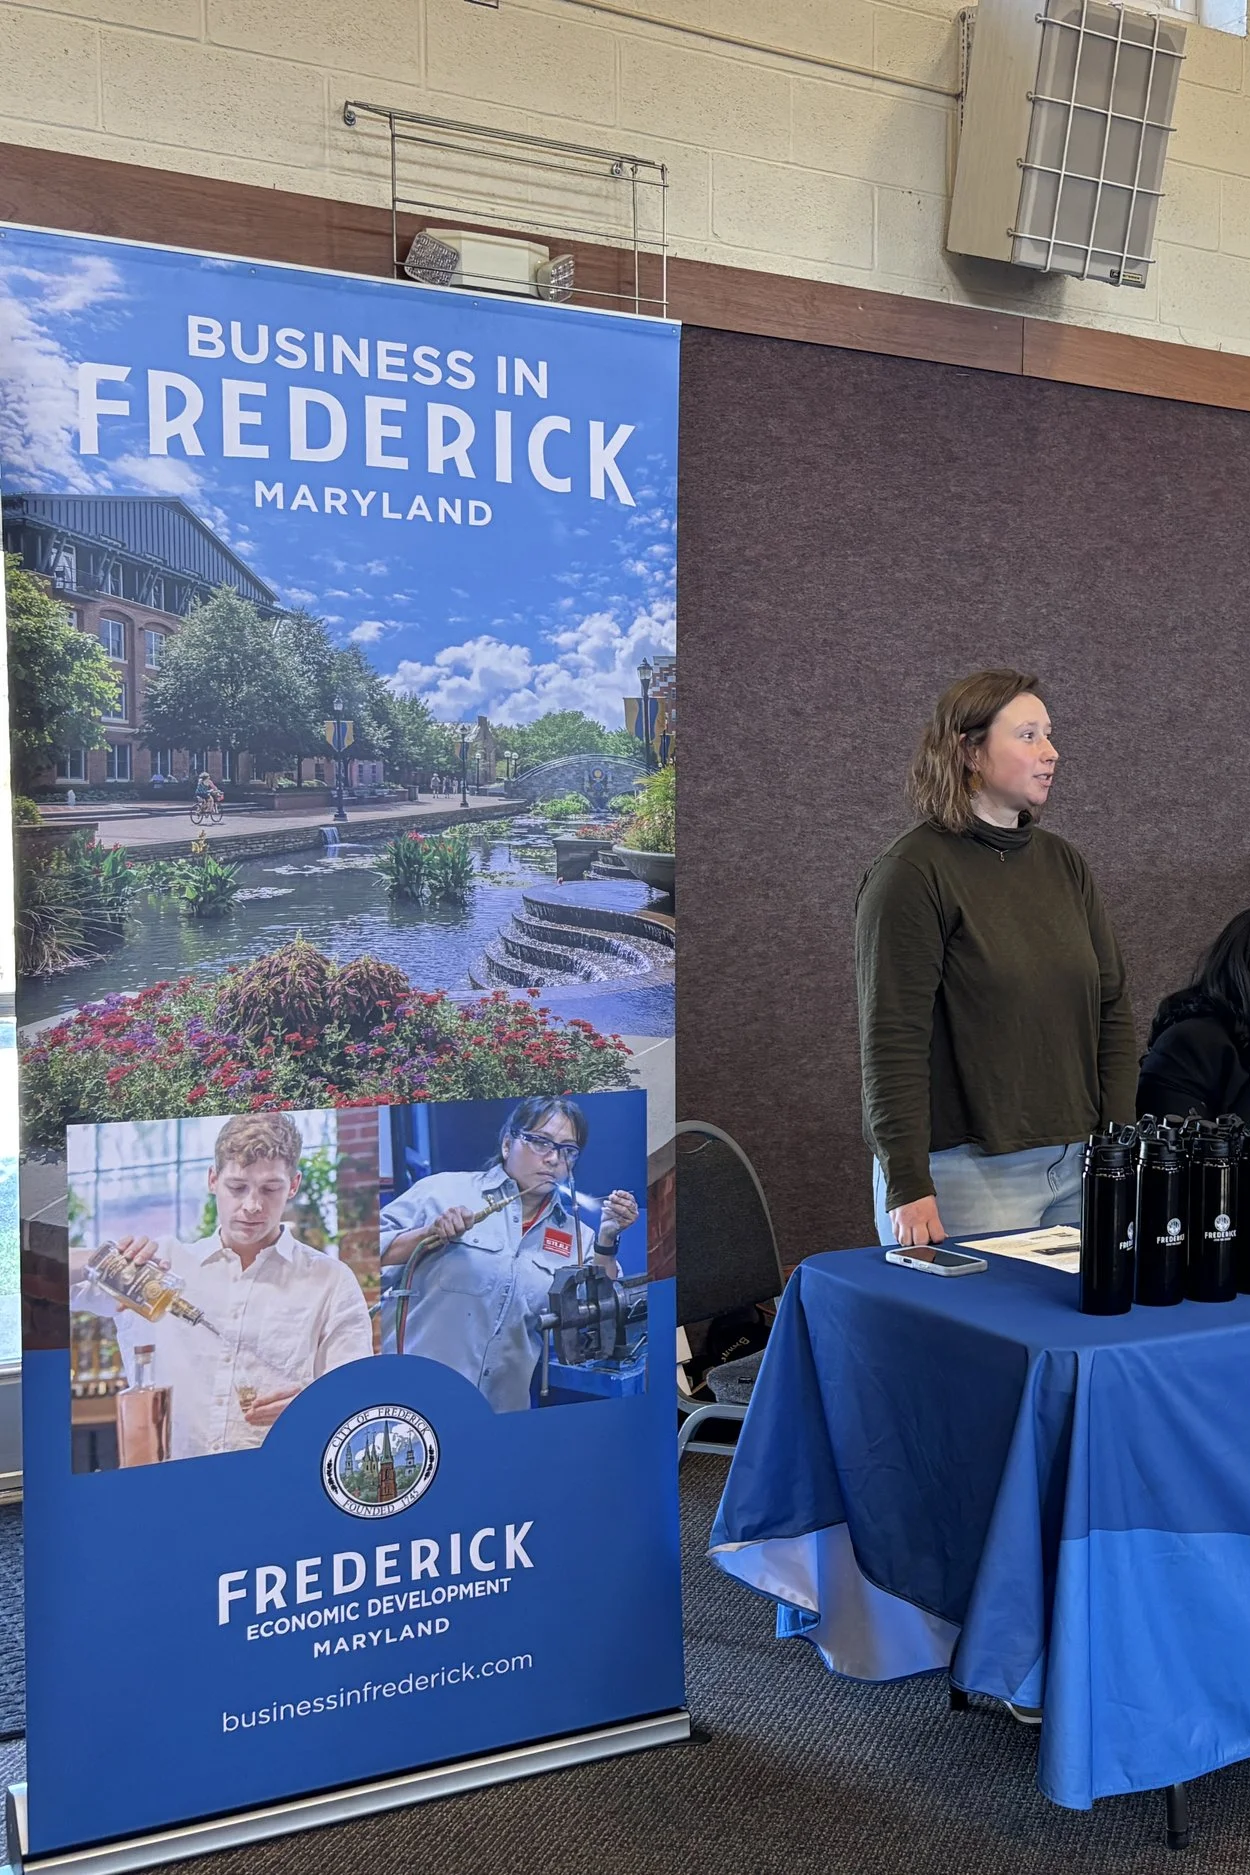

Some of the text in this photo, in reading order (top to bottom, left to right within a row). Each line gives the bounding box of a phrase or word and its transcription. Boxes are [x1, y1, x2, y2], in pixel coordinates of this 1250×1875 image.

[187, 315, 548, 399] BUSINESS IN
[78, 362, 636, 507] FREDERICK
[254, 480, 492, 526] MARYLAND
[1204, 1229, 1237, 1240] FREDERICK
[332, 1407, 431, 1448] CITY OF FREDERICK
[342, 1489, 419, 1516] FOUNDED 1745
[218, 1520, 535, 1626] FREDERICK
[246, 1577, 512, 1641] ECONOMIC DEVELOPMENT
[313, 1617, 450, 1659] MARYLAND
[222, 1652, 534, 1733] businessinfrederick.com
